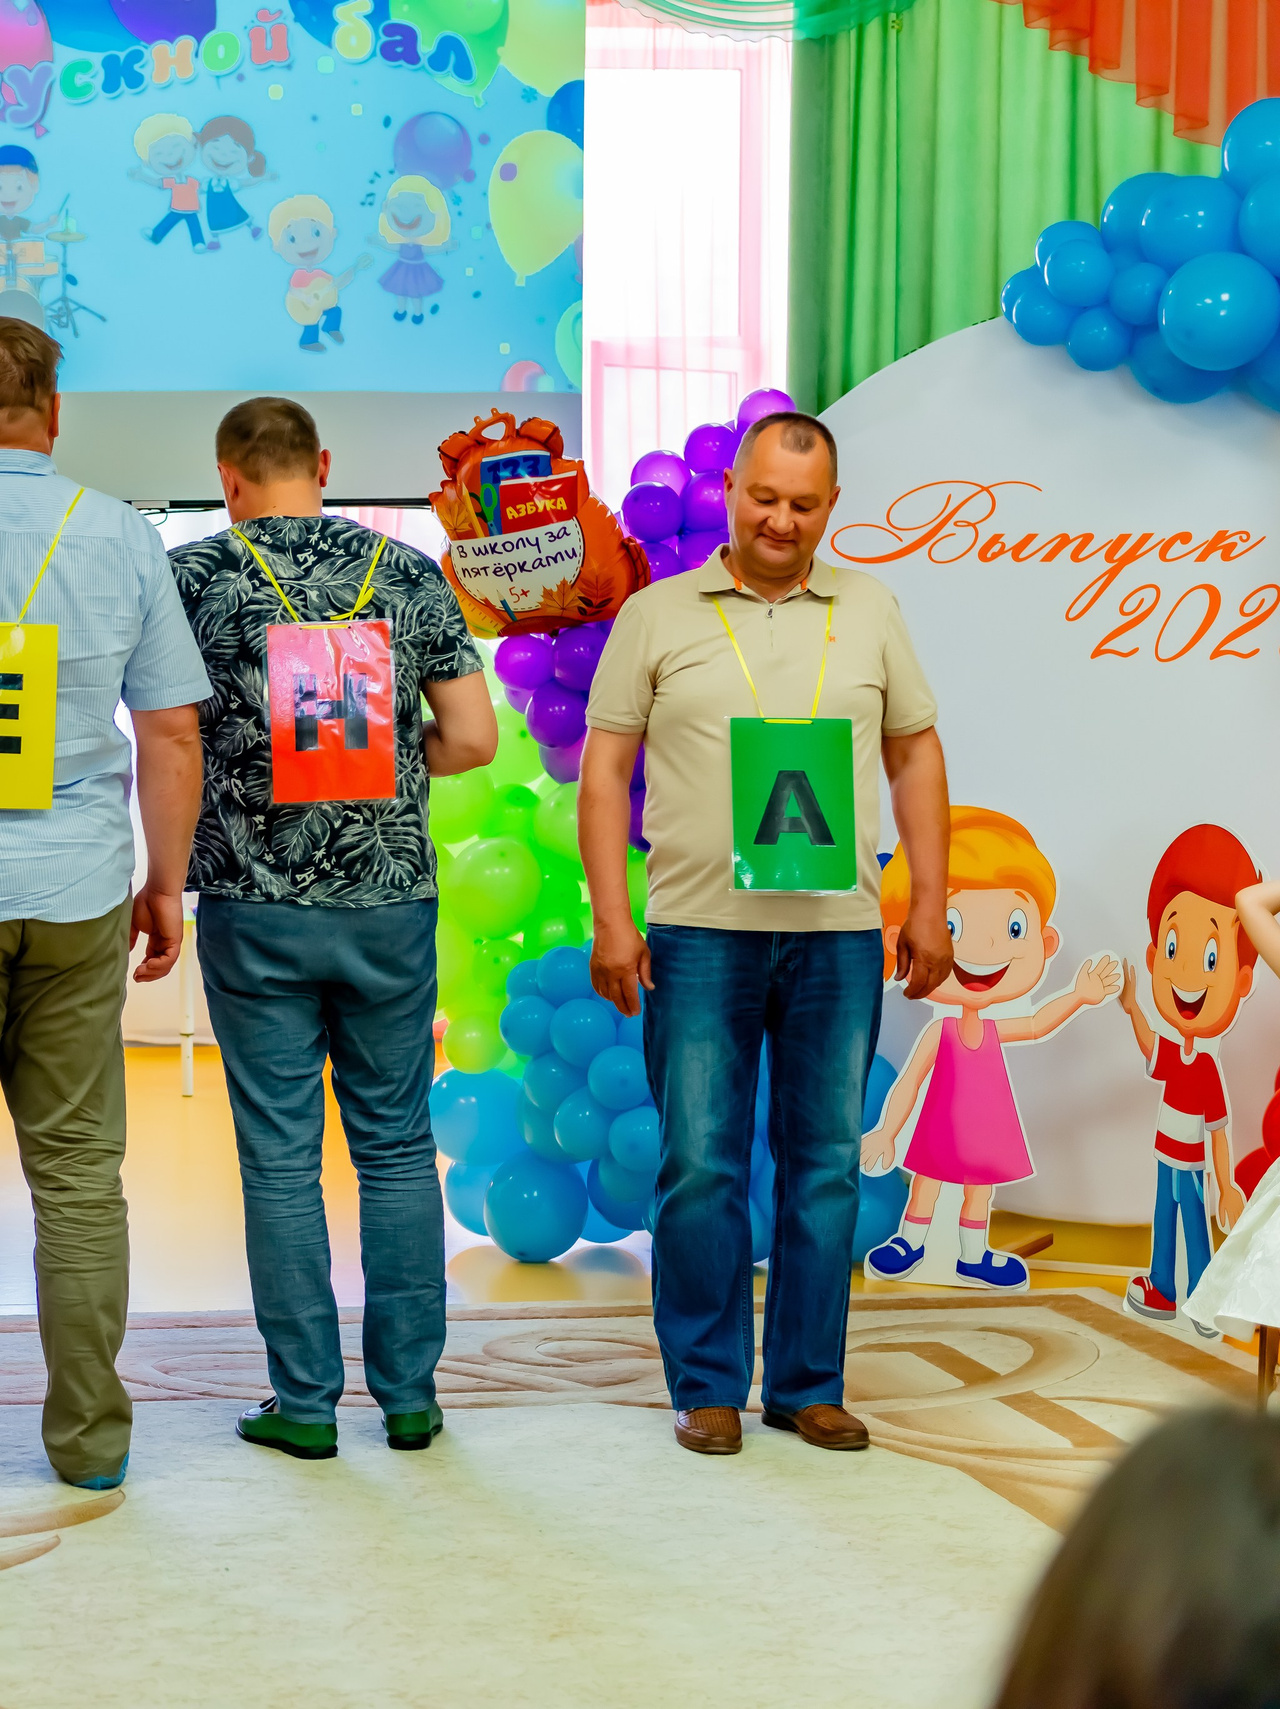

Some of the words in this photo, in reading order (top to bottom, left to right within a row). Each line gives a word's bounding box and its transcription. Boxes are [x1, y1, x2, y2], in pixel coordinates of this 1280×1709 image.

[335, 0, 477, 84] бал
[472, 535, 540, 557] школу
[544, 526, 571, 542] за
[506, 498, 567, 519] АЗБУКА
[461, 547, 578, 582] пятёрками
[830, 480, 1266, 622] Выпуск
[508, 586, 531, 604] 5+
[1090, 583, 1280, 663] 202
[293, 672, 369, 752] Н
[753, 770, 837, 846] А
